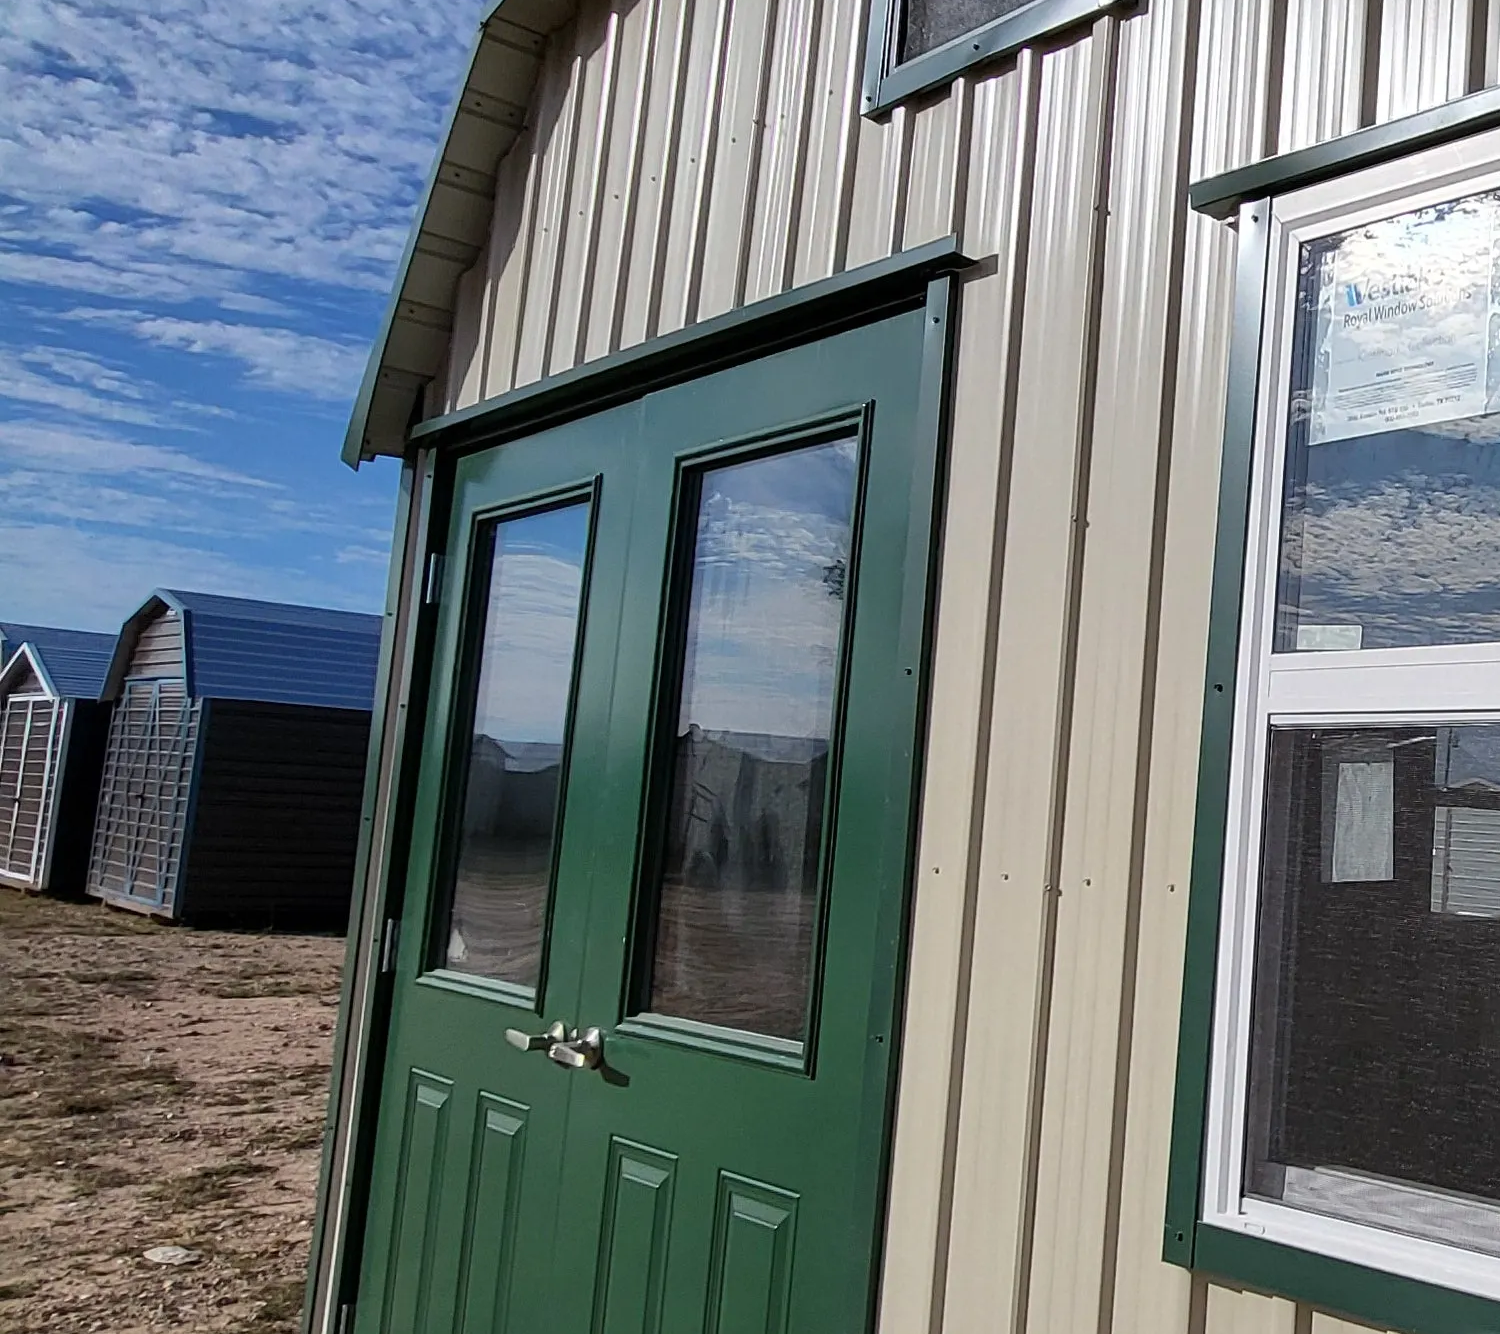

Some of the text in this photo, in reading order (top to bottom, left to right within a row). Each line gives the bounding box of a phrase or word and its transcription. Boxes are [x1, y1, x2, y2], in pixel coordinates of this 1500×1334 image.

[1343, 286, 1472, 329] Royal Window Solutns
